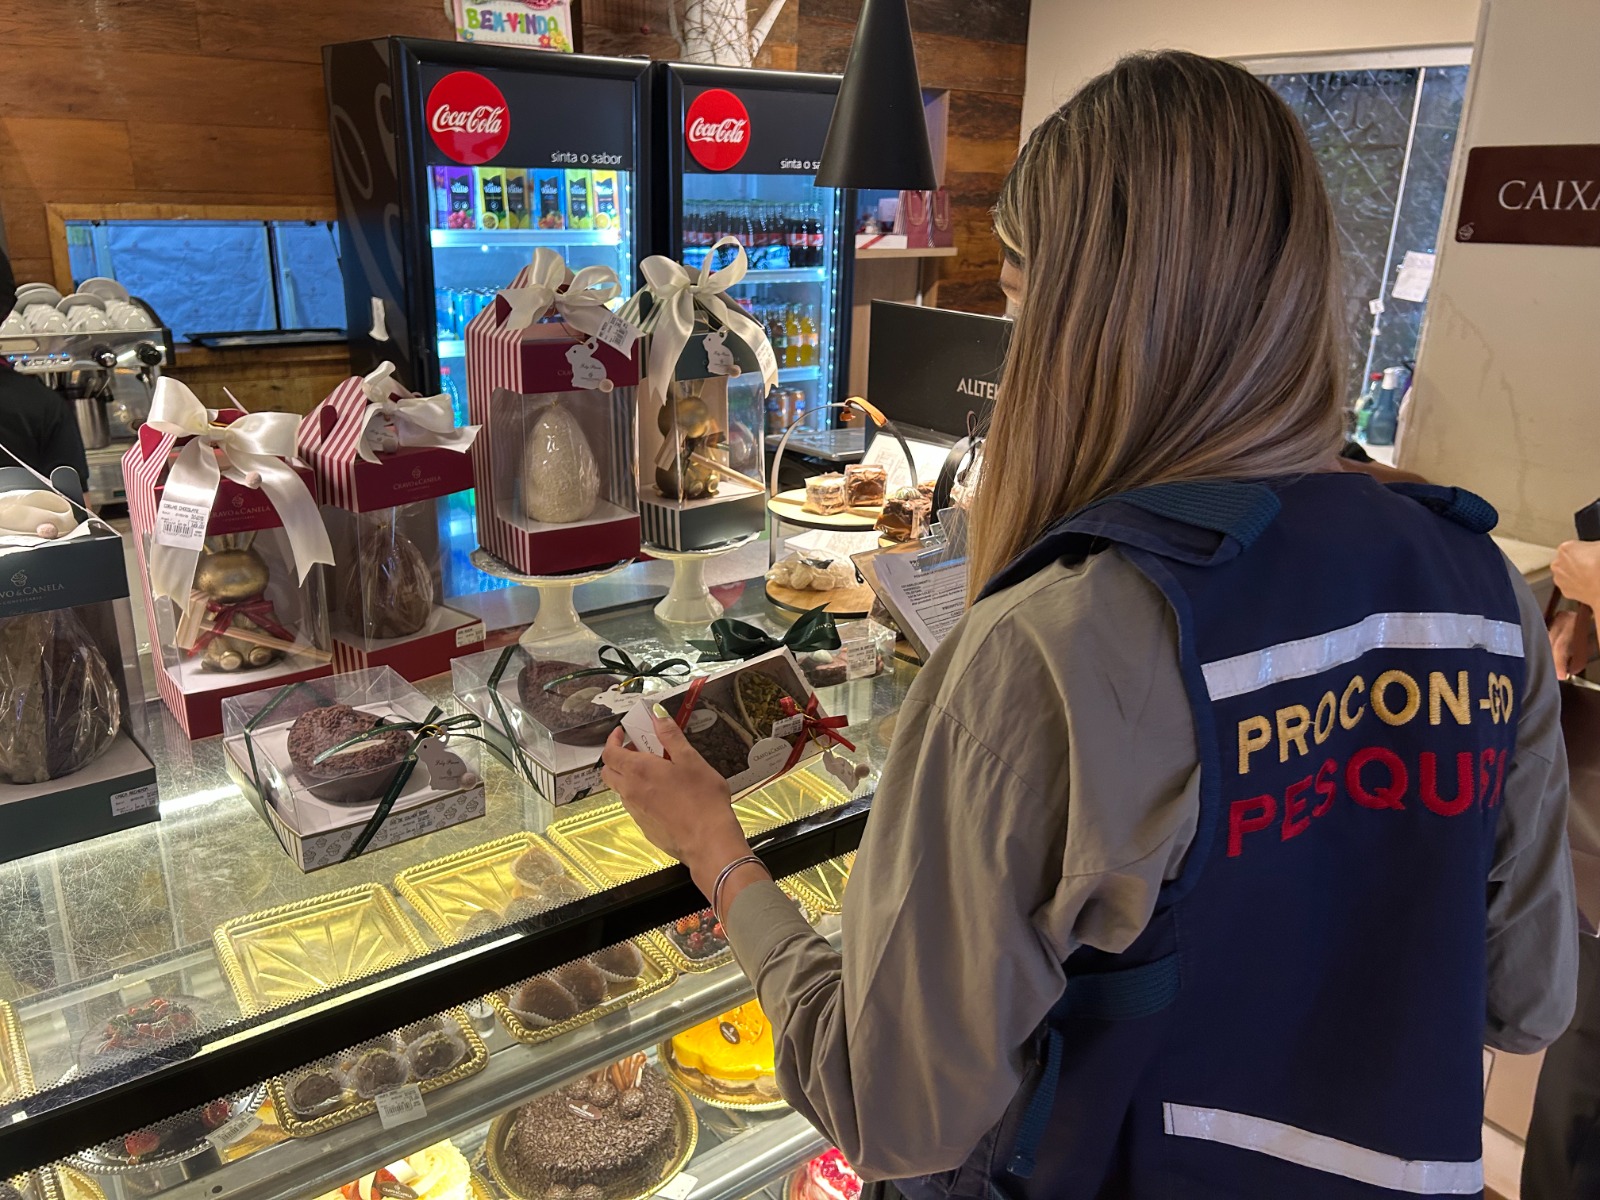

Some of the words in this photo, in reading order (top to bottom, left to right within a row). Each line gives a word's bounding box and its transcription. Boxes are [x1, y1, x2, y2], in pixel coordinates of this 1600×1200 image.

[432, 103, 507, 135] Coca-Cola
[689, 117, 748, 144] Coca-Cola
[551, 150, 577, 163] sinta
[580, 153, 589, 164] o
[591, 152, 622, 165] sabor
[780, 158, 802, 169] sinta
[802, 160, 811, 170] o
[212, 510, 235, 518] RAVO
[240, 506, 271, 515] CANELA
[23, 583, 65, 595] CANELA
